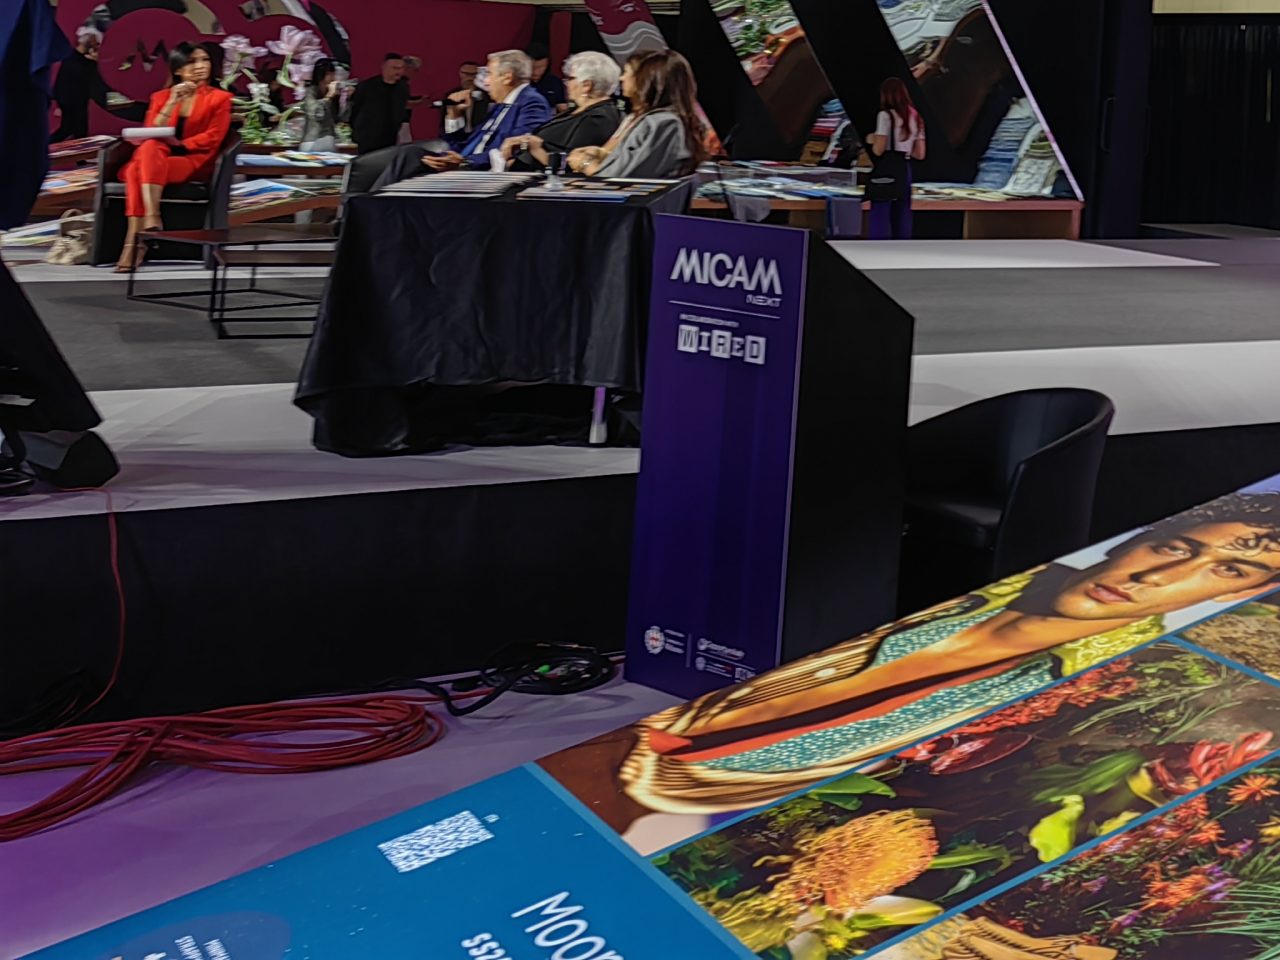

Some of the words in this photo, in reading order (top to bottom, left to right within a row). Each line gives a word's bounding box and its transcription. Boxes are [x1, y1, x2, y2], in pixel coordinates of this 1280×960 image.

[670, 247, 783, 295] MICAM
[677, 324, 766, 365] WIRED
[461, 932, 512, 960] SS2
